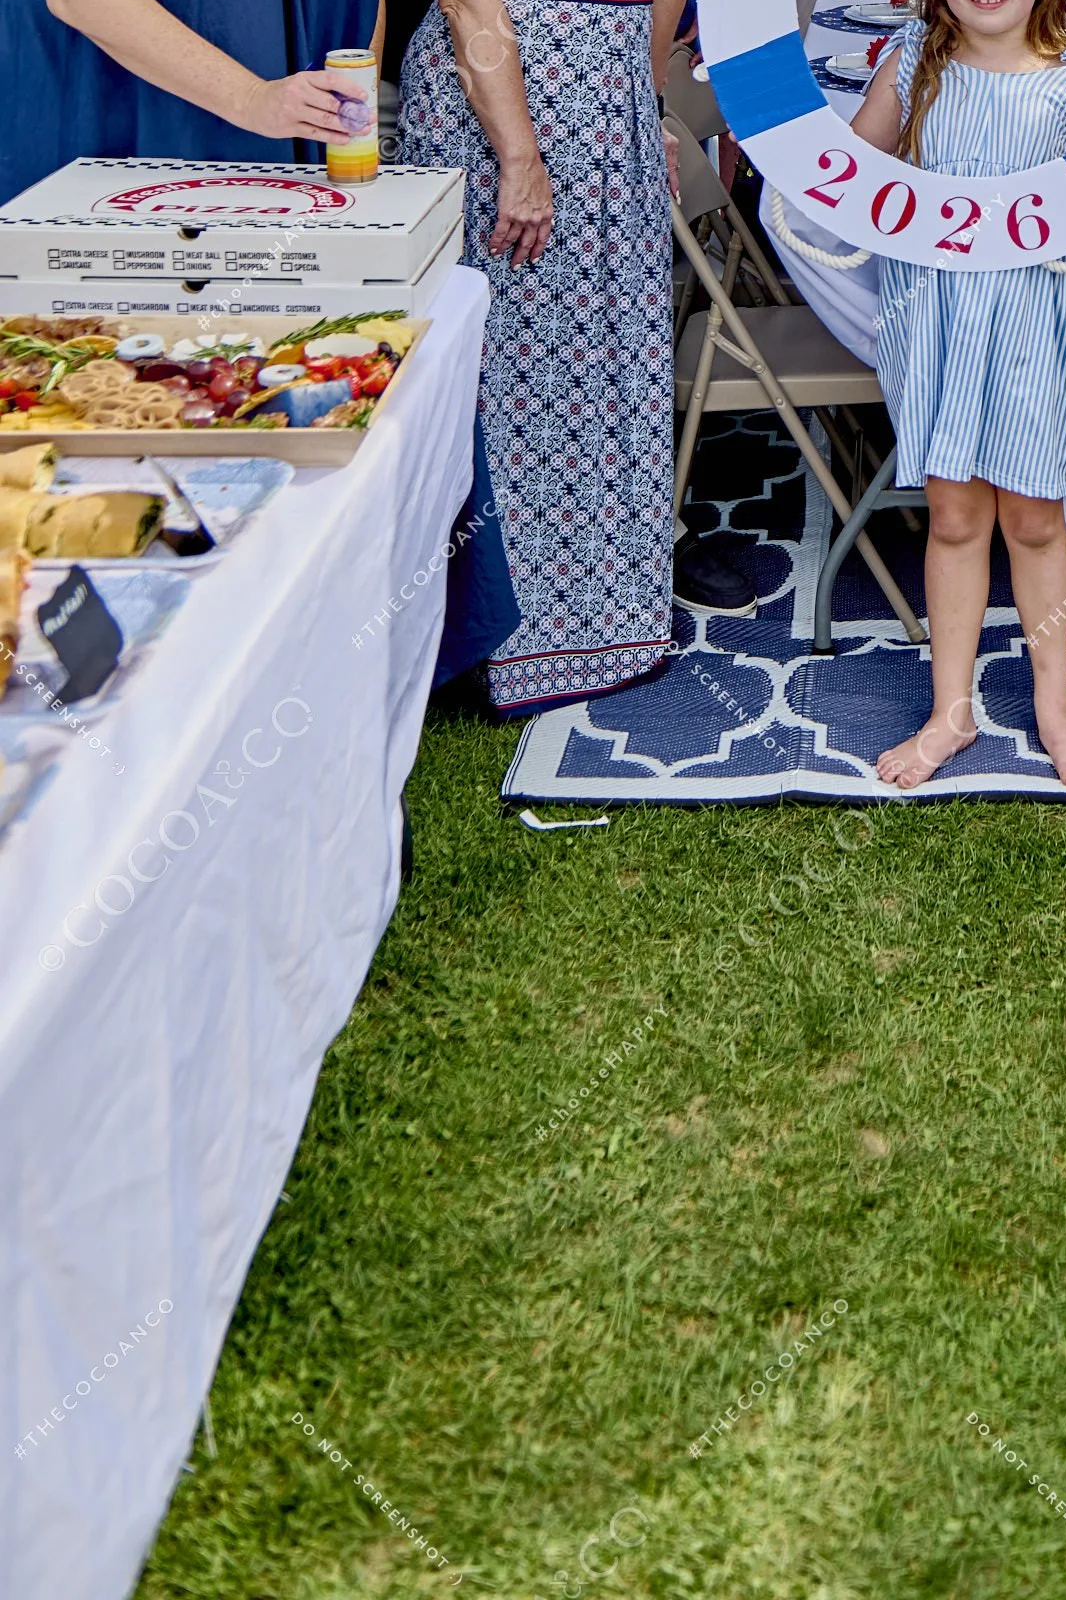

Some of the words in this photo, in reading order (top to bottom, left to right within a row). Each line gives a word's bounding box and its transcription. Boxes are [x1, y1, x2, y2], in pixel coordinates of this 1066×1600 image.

[118, 182, 192, 204] Fresh
[200, 179, 283, 188] Oven
[803, 148, 1050, 255] 2026
[61, 250, 82, 258] EXTRA
[83, 250, 109, 258] CHEESE
[126, 251, 165, 259] MUSHROOM
[206, 252, 220, 260] BALL
[238, 252, 275, 260] ANCHOVIES
[281, 252, 317, 260] CUSTOMER
[61, 261, 92, 269] SAUSAGE
[127, 262, 164, 270] PEPPERONI
[186, 262, 212, 270] ONIONS
[295, 263, 320, 271] SPECIAL
[65, 302, 86, 310] EXTRA
[88, 302, 114, 310] CHEESE
[131, 303, 170, 311] MUSHROOM
[242, 304, 280, 312] ANCHOVIES
[285, 304, 321, 312] CUSTOMER
